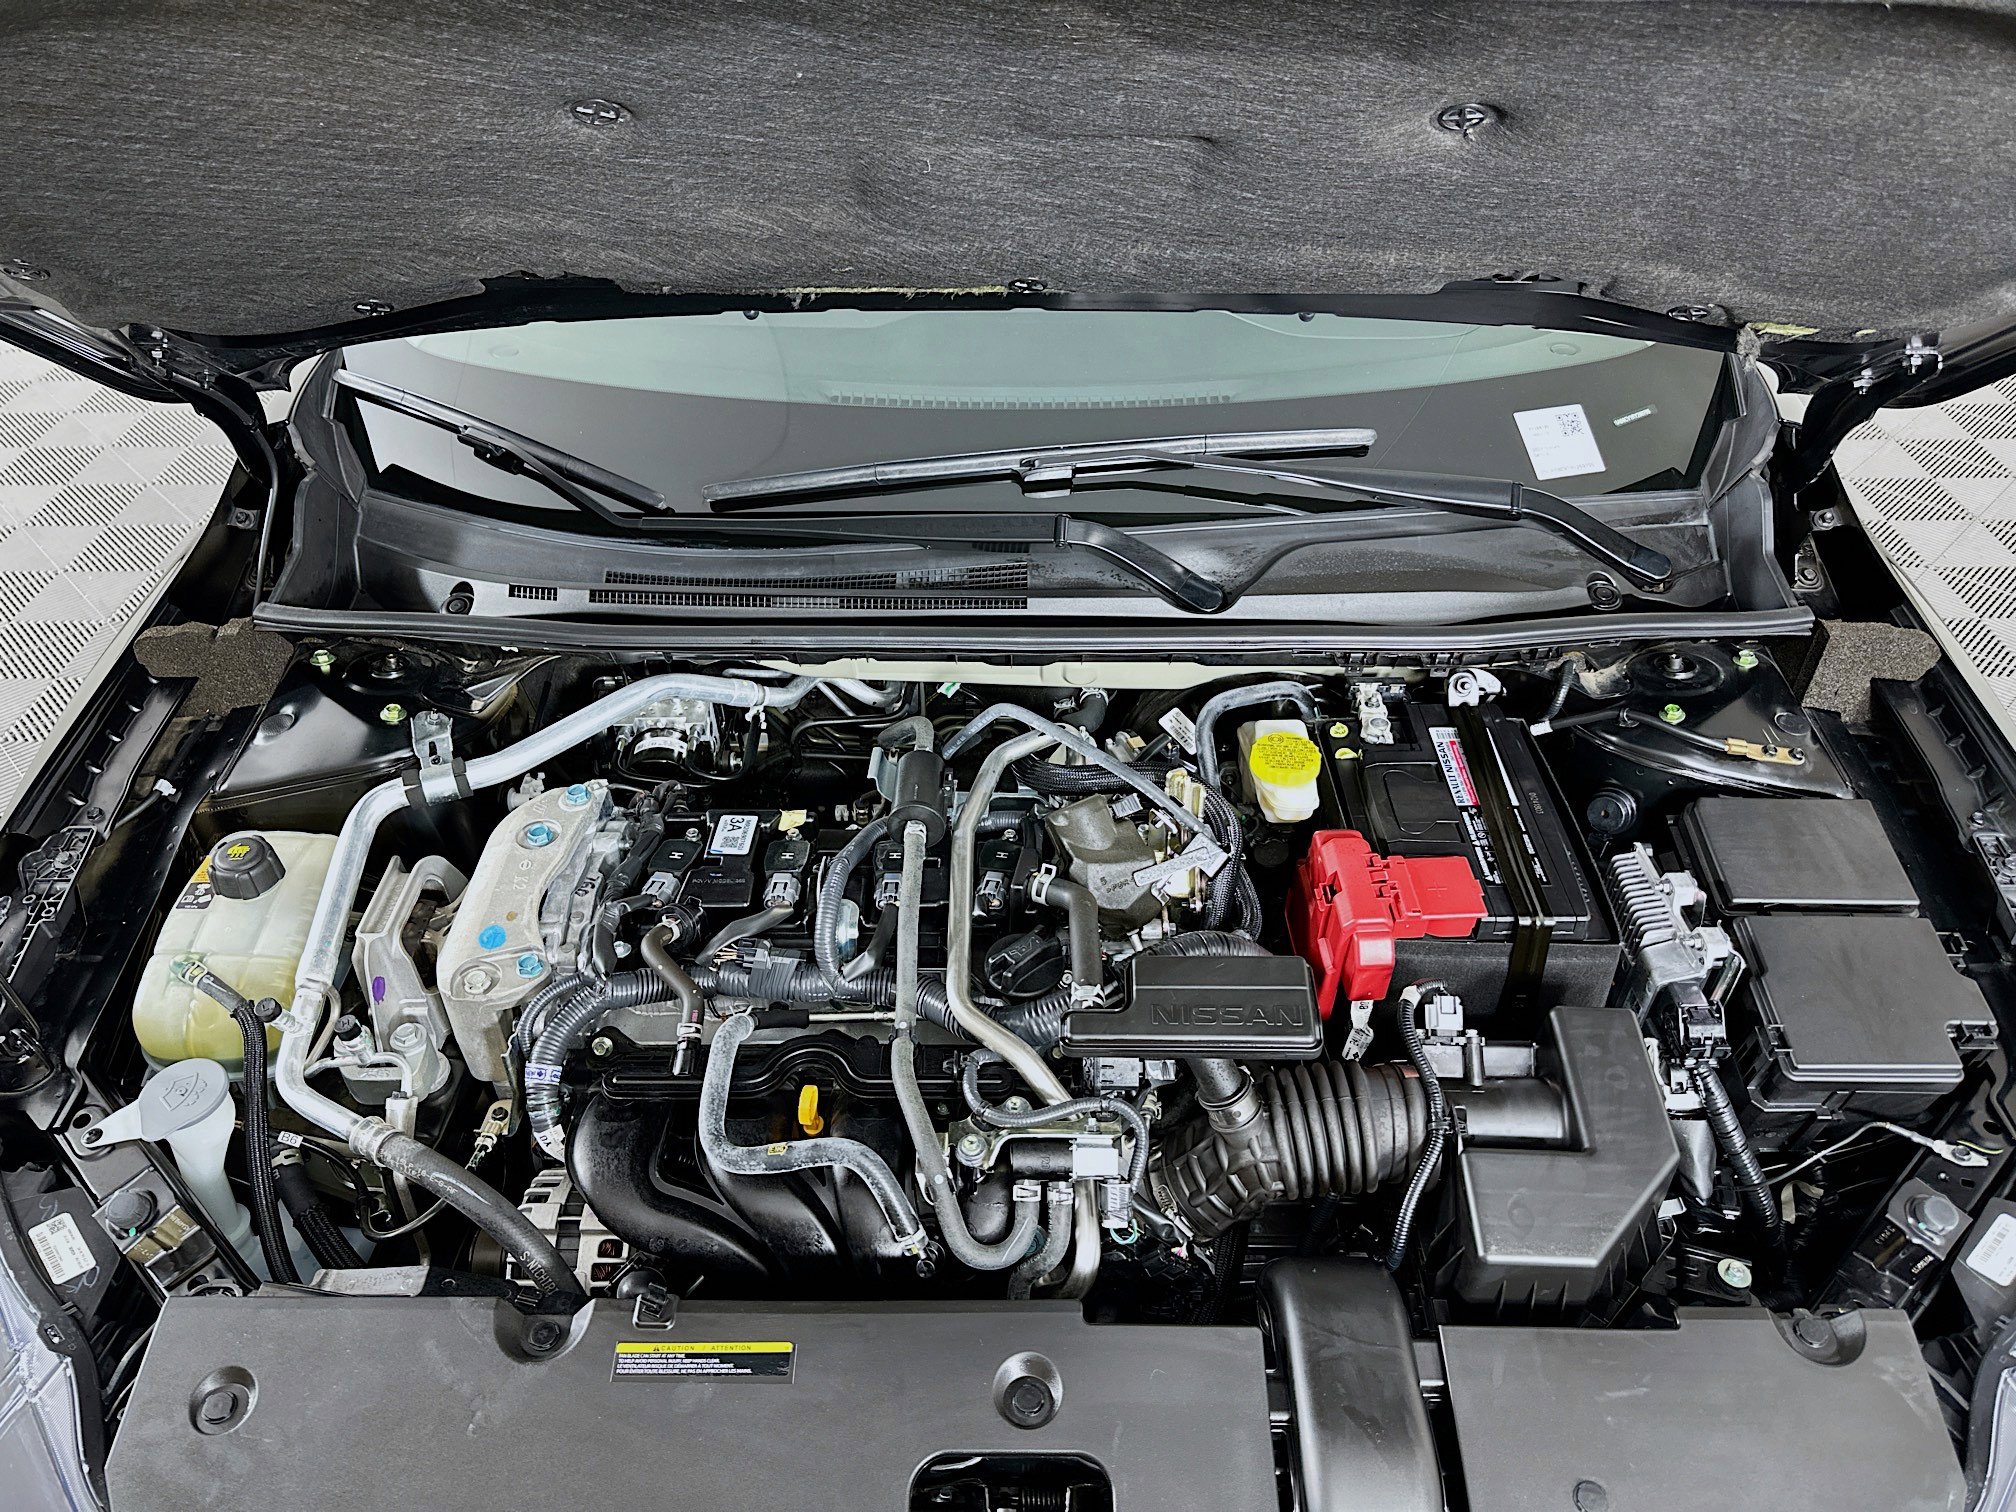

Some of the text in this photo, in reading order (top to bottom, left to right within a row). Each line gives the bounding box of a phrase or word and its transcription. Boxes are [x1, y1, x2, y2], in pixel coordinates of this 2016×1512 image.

[1437, 741, 1455, 777] NISSAN
[727, 817, 745, 832] 3A
[1151, 1003, 1304, 1026] NISSAN
[281, 1133, 299, 1145] B6
